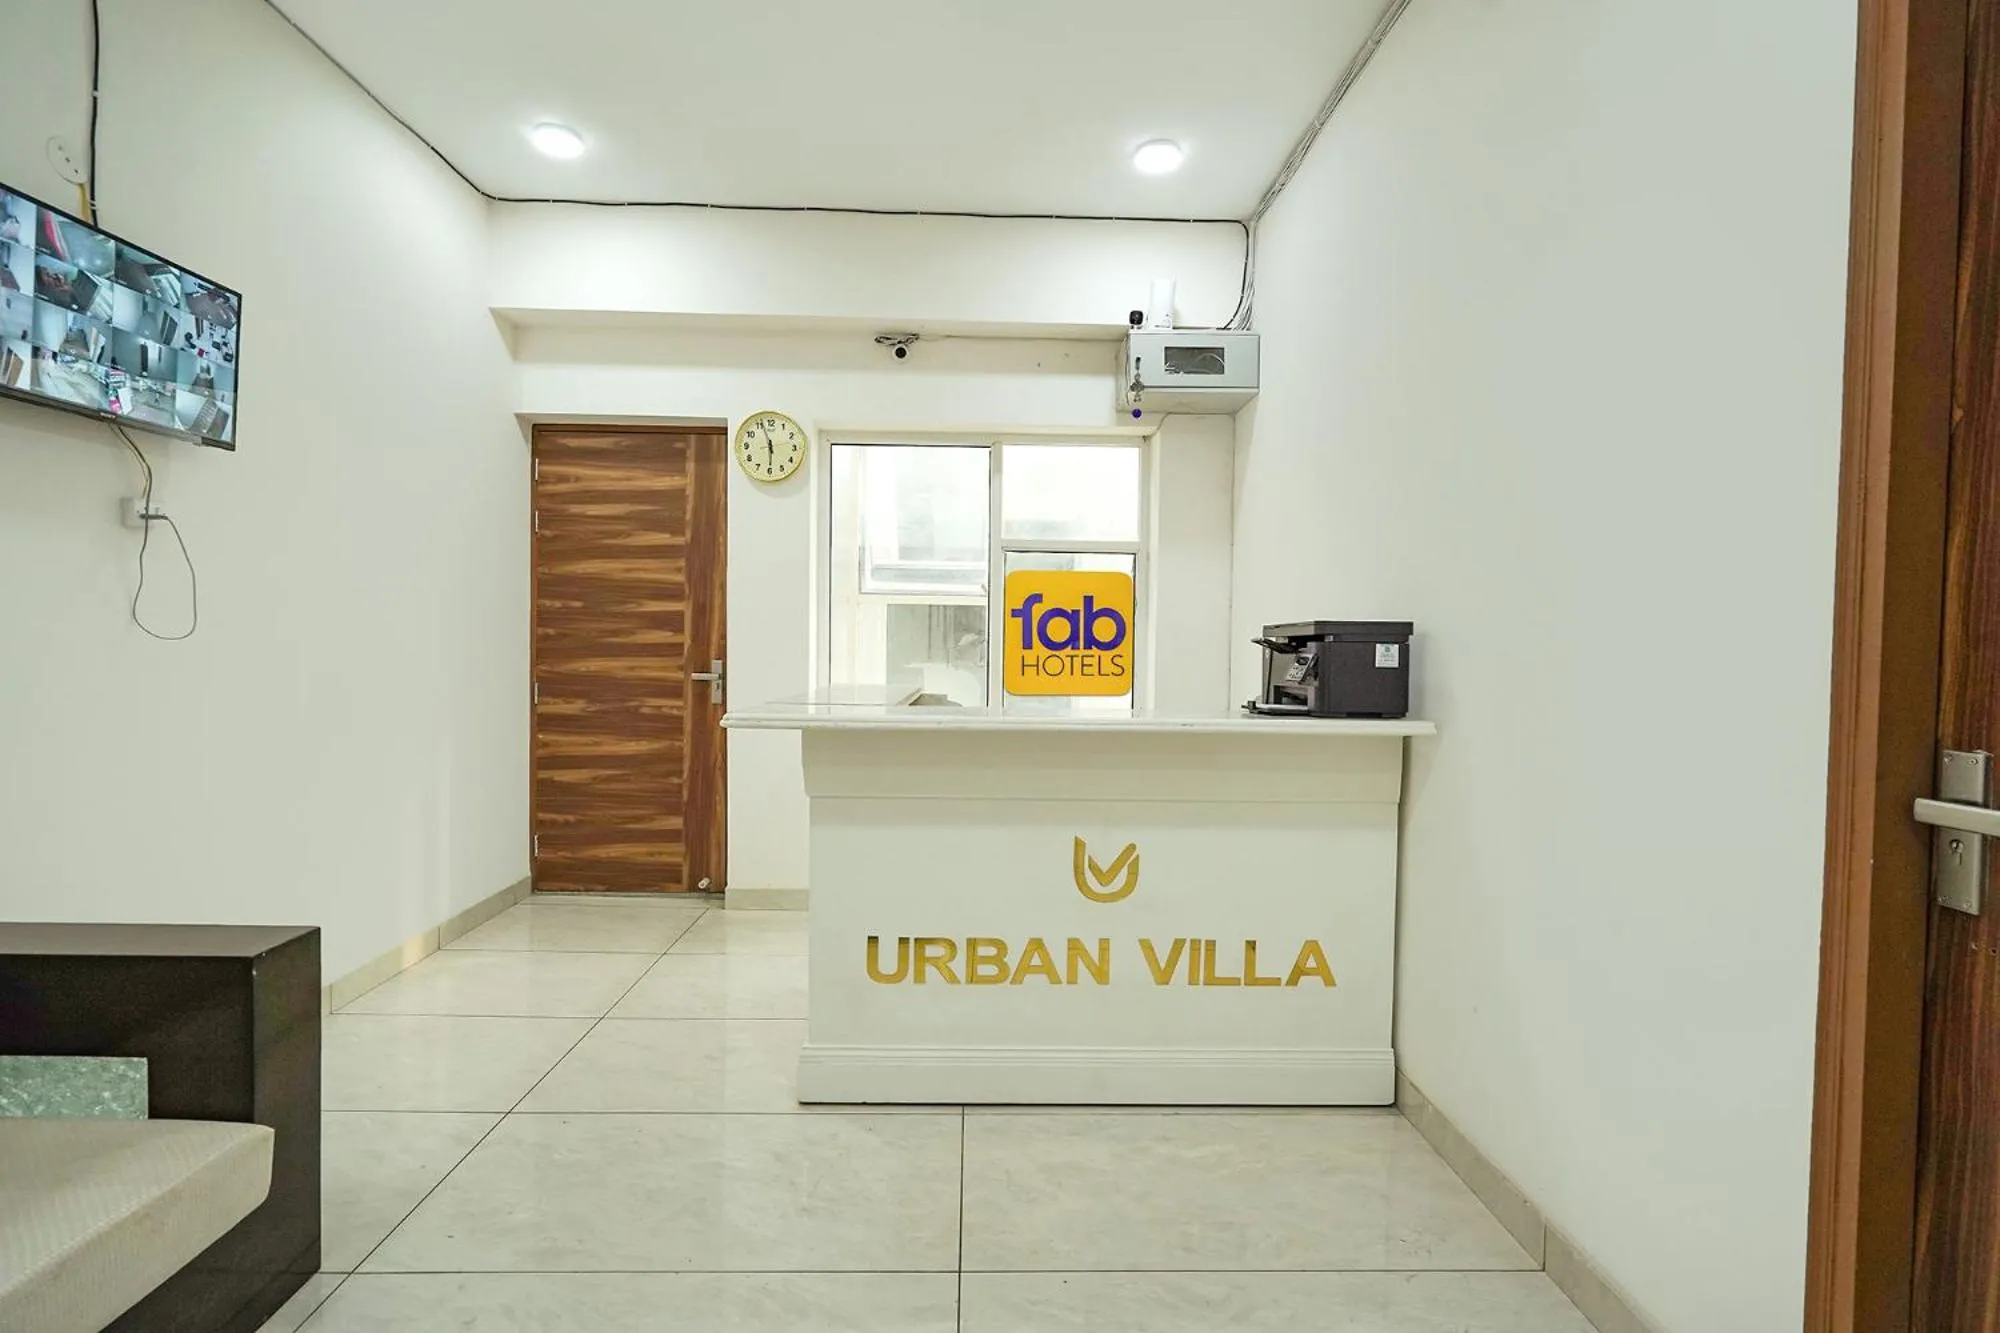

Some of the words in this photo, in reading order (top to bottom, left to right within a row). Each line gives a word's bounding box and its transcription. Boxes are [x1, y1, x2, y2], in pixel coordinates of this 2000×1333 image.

[767, 419, 776, 427] 12
[789, 432, 794, 440] 2
[743, 442, 750, 450] 9
[791, 444, 797, 452] 3
[746, 454, 752, 462] 8
[755, 463, 761, 471] 7
[767, 467, 773, 475] 6
[1011, 593, 1126, 651] fab
[1020, 654, 1125, 677] HOTELS
[866, 936, 1110, 985] URBAN
[1138, 938, 1337, 987] VILLA
